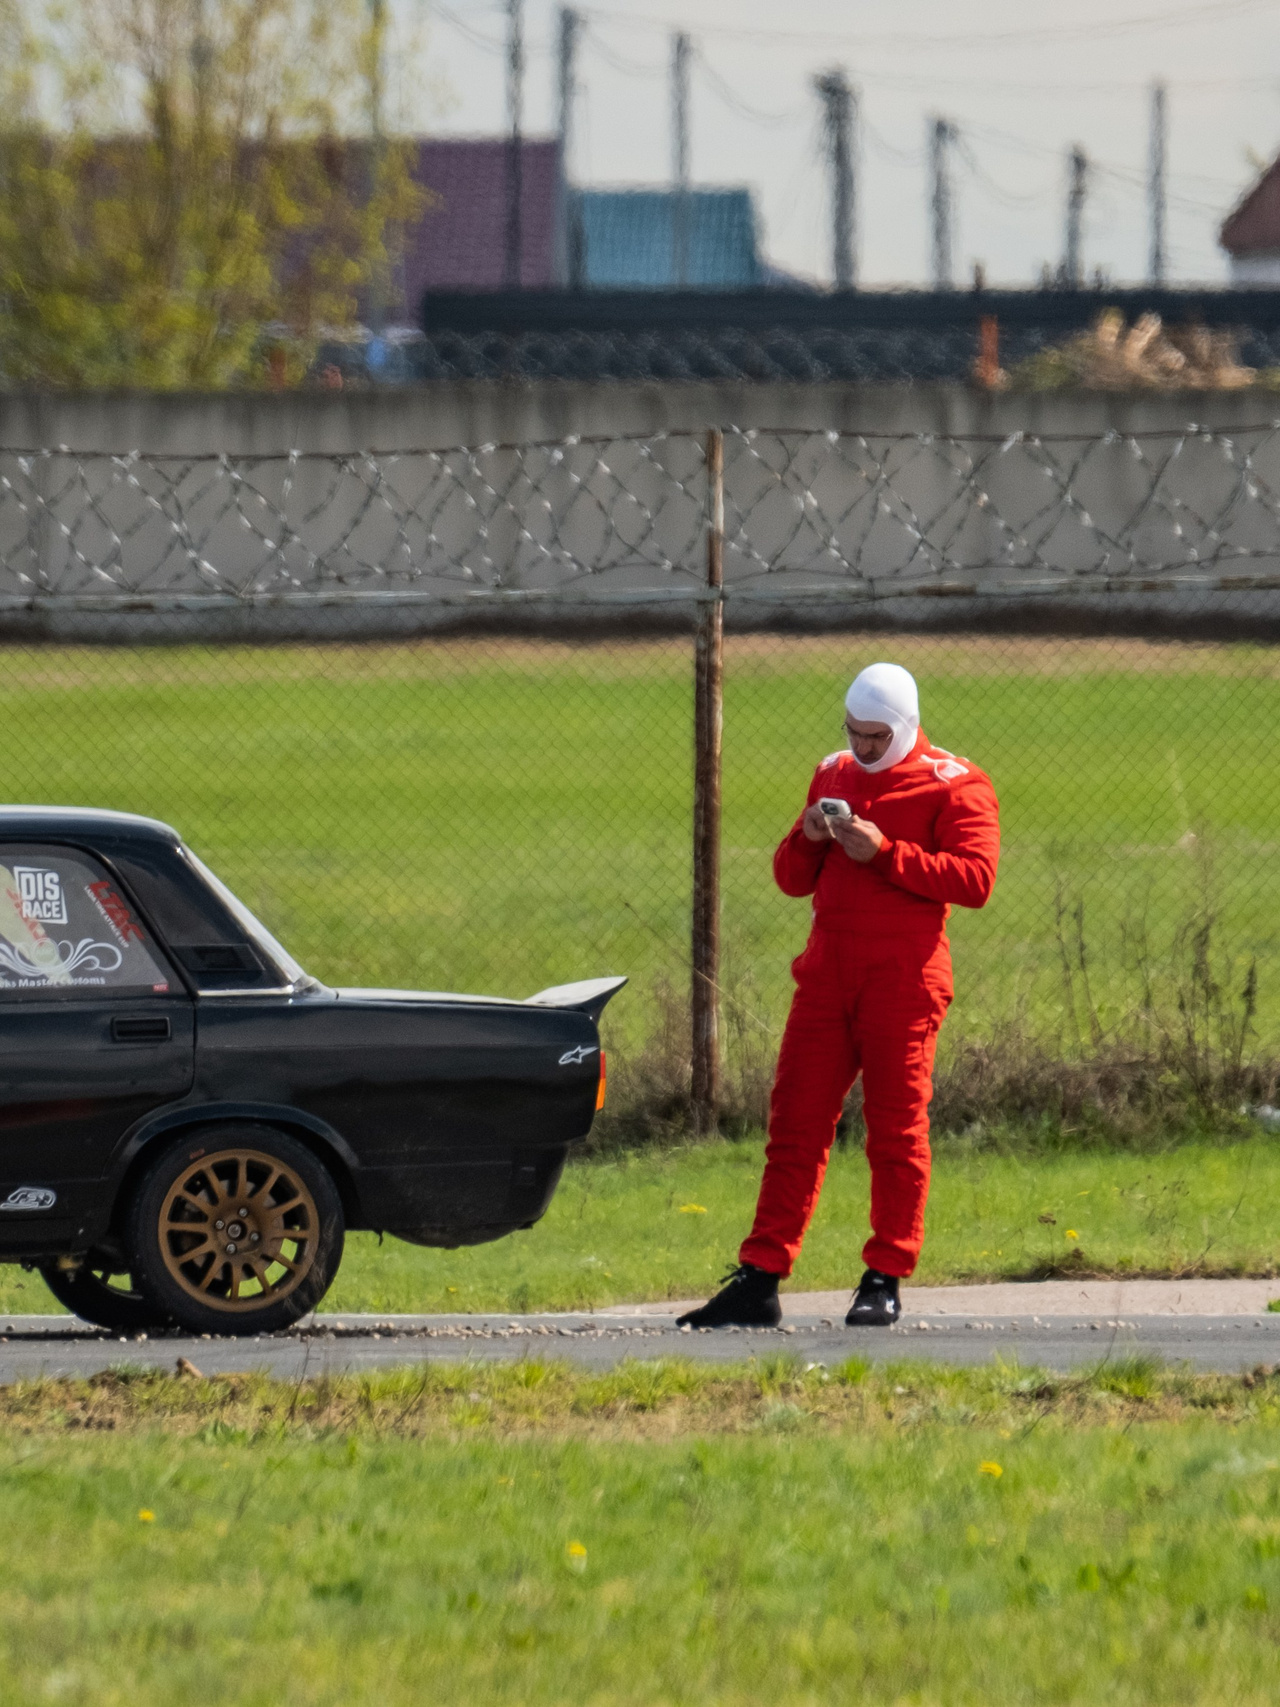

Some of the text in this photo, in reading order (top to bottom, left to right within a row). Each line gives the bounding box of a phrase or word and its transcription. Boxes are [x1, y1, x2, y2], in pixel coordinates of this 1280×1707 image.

[20, 872, 60, 901] DIS
[22, 901, 62, 919] RACE
[89, 880, 145, 942] LTAC
[18, 978, 58, 988] Master
[59, 976, 106, 986] Customs
